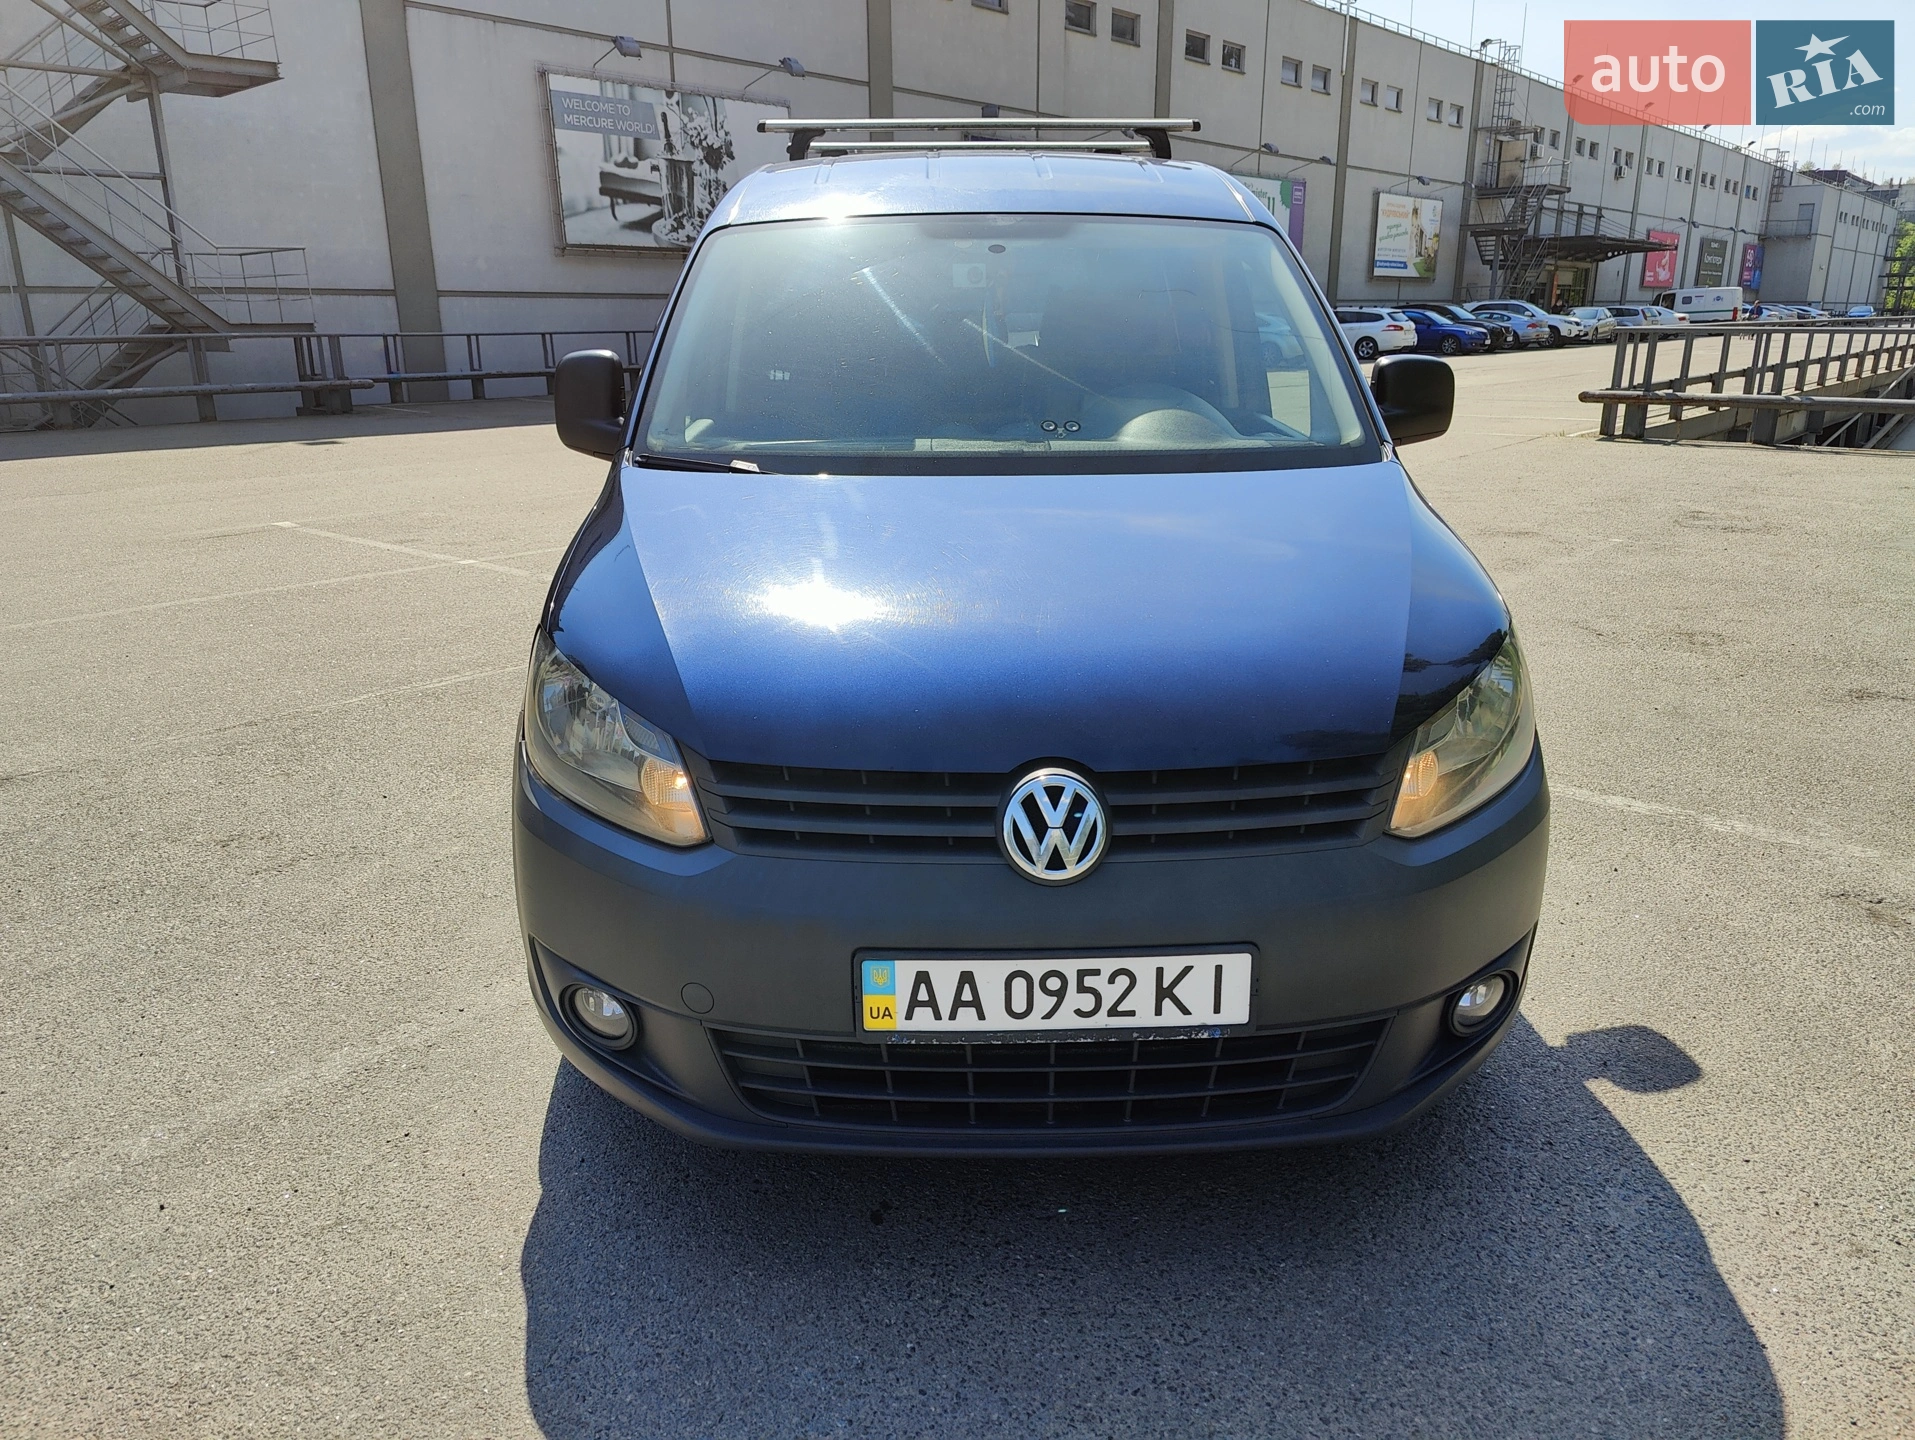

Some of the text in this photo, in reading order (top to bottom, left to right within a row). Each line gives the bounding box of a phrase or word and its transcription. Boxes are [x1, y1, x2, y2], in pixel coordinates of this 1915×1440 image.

[562, 97, 631, 116] WELCOME TO
[563, 113, 656, 135] MERCURE WORLD!
[904, 964, 1223, 1021] AA 0952 KI
[869, 1006, 893, 1020] UA
